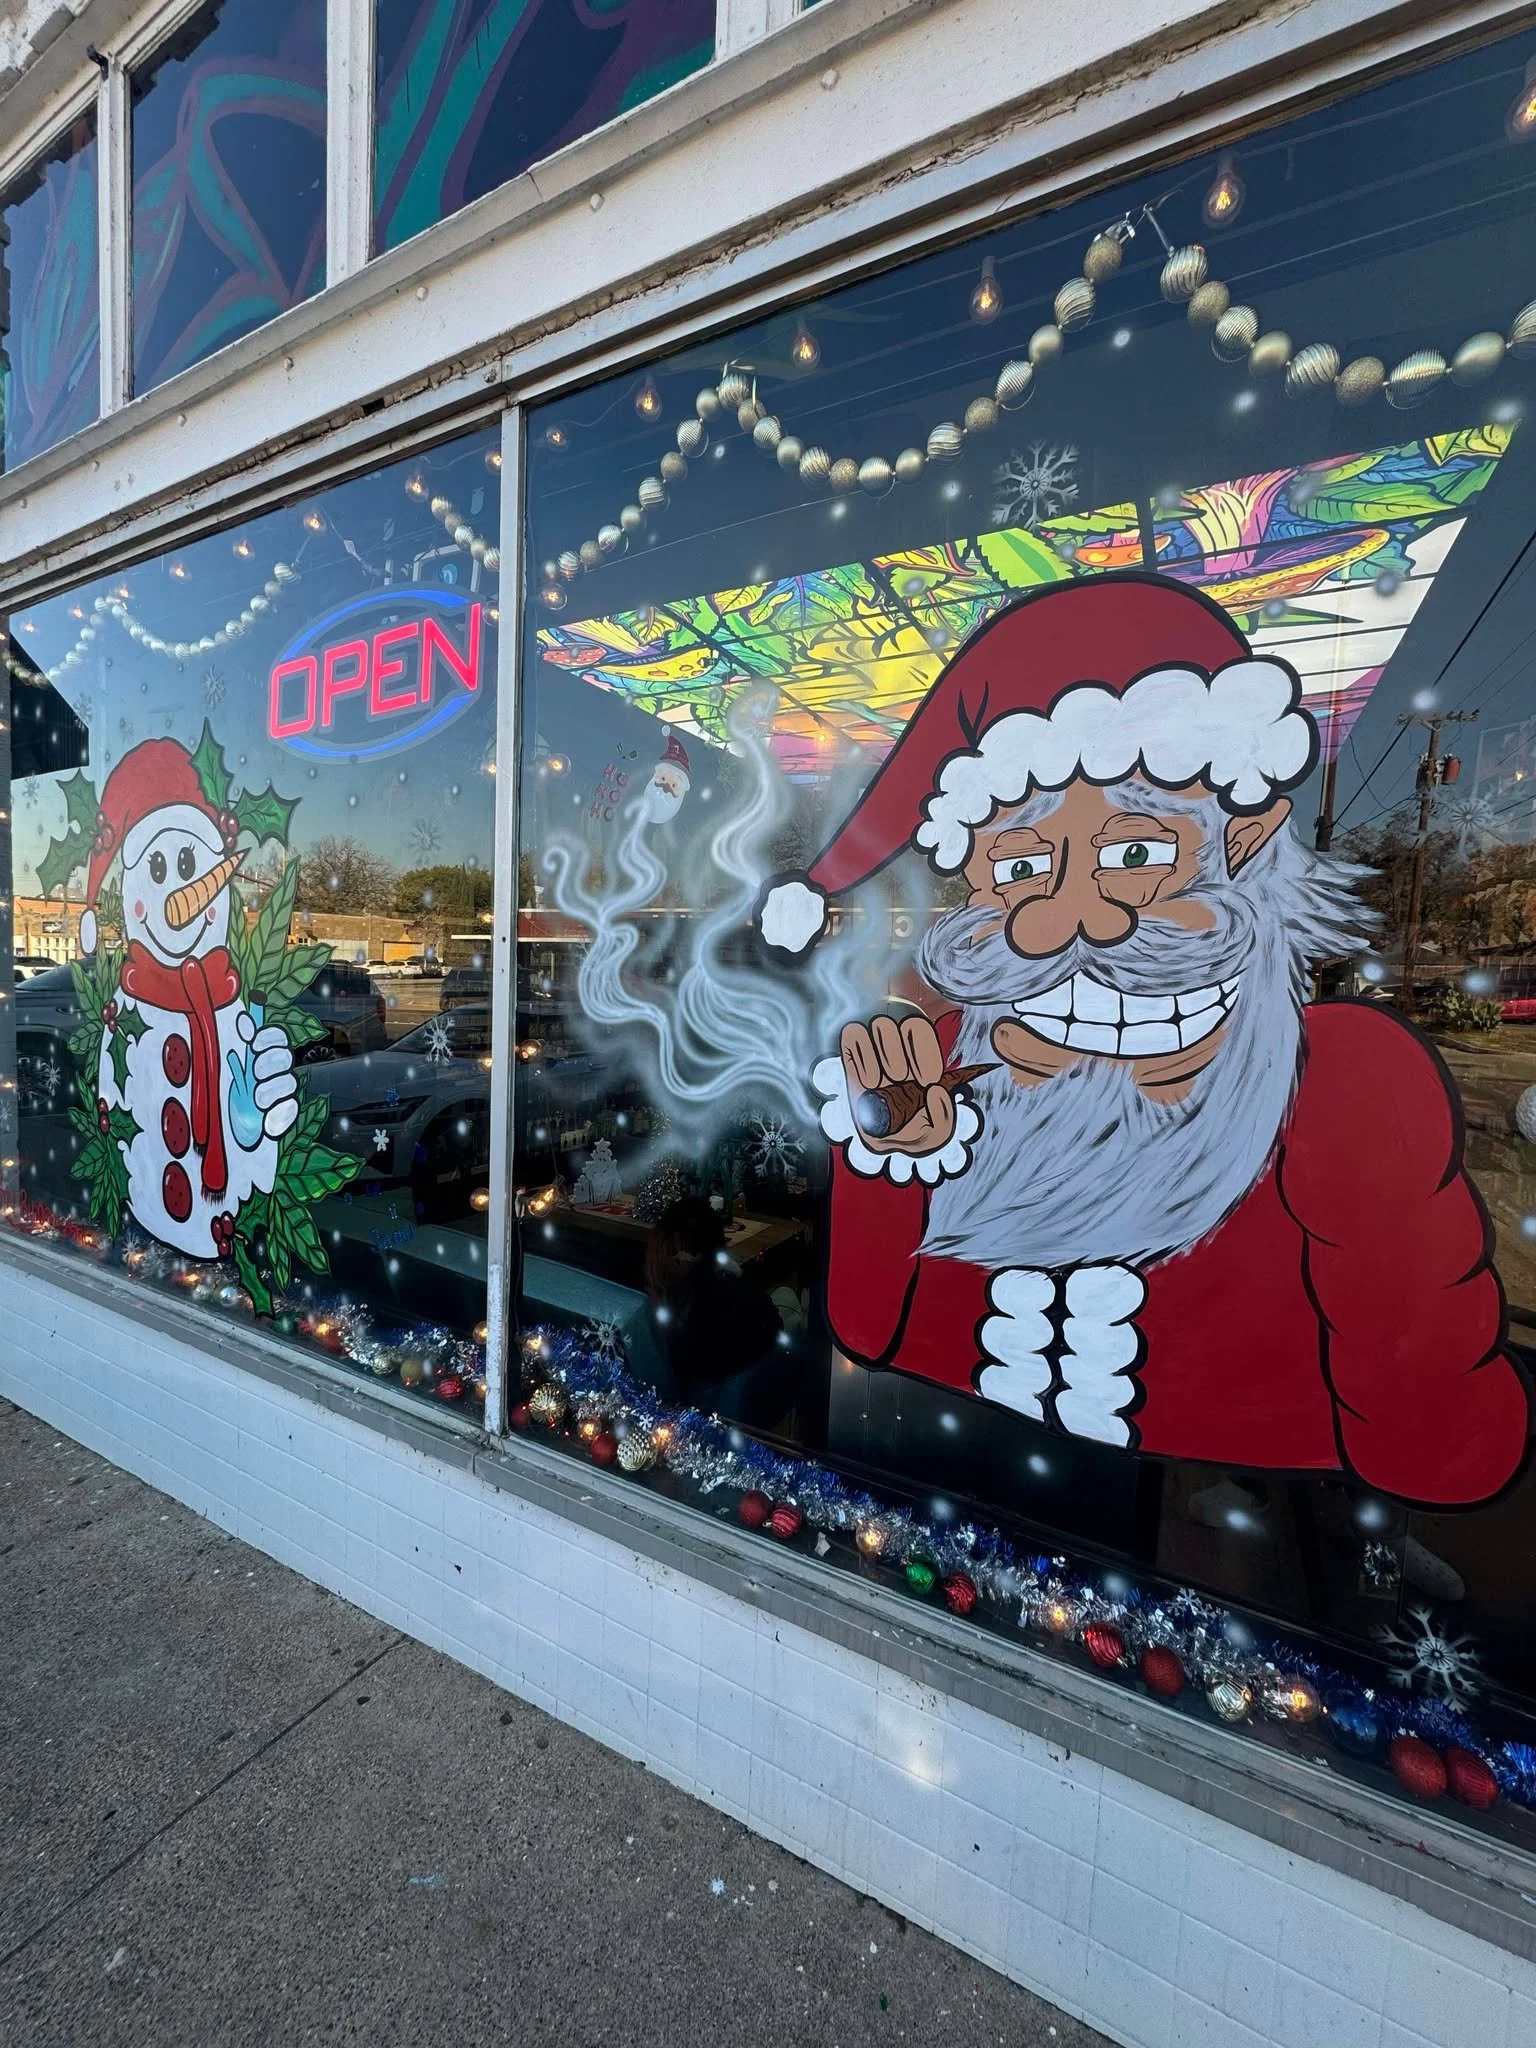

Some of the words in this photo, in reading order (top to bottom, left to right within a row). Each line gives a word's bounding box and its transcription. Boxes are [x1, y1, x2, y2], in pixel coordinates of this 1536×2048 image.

[270, 603, 481, 739] OPEN
[602, 763, 630, 787] HO
[595, 783, 622, 803] HO
[590, 802, 615, 822] HO
